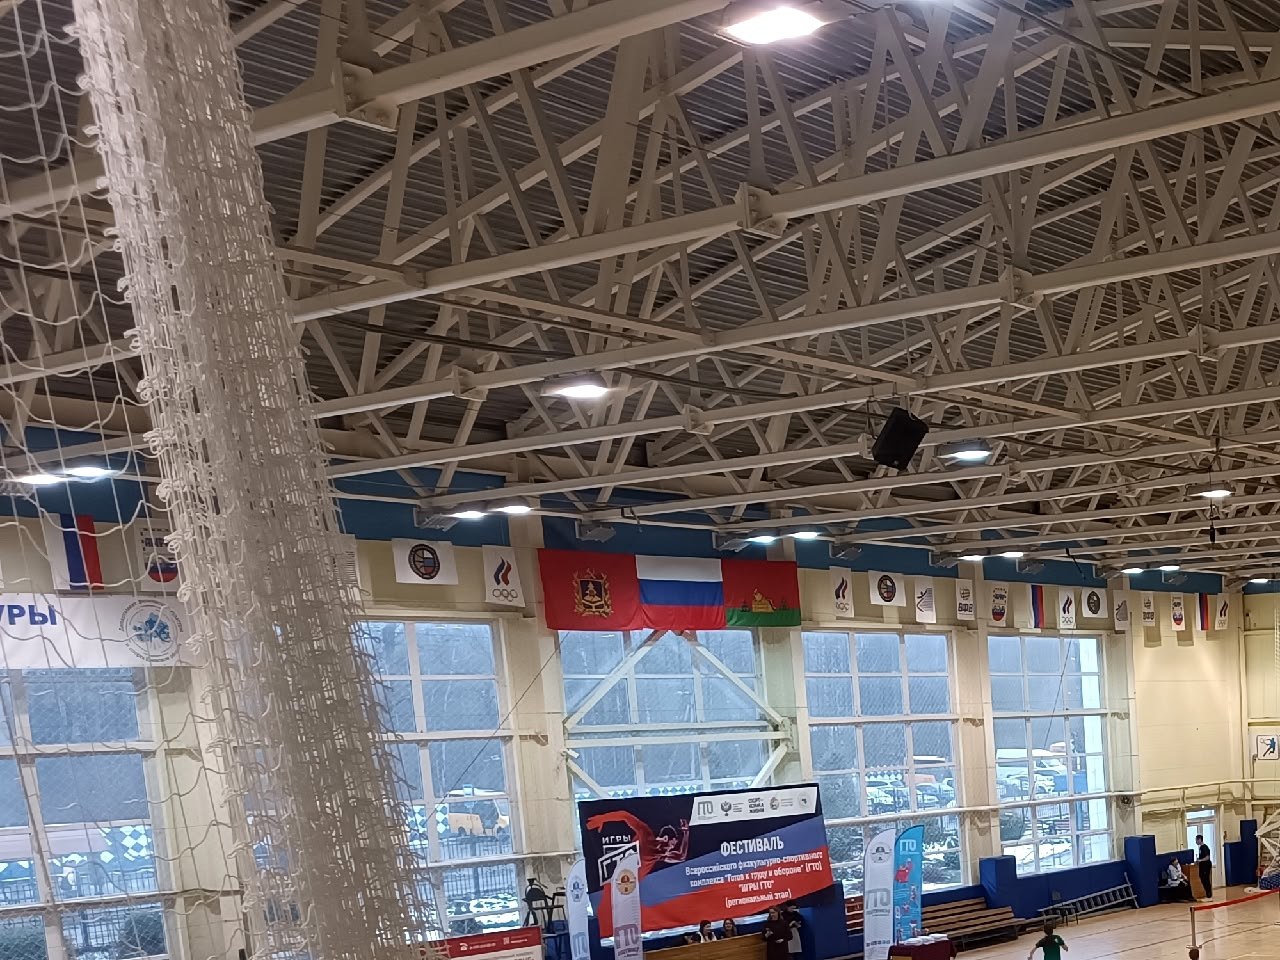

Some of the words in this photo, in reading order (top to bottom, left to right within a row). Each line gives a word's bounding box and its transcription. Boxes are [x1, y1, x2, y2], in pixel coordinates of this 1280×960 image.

[602, 834, 631, 844] ИГРЫ
[720, 835, 784, 857] ФЕСТИВАЛЬ
[685, 861, 738, 876] Всероссийского
[689, 875, 725, 888] комплекса
[750, 869, 768, 882] труду
[805, 860, 823, 873] (ГТО)
